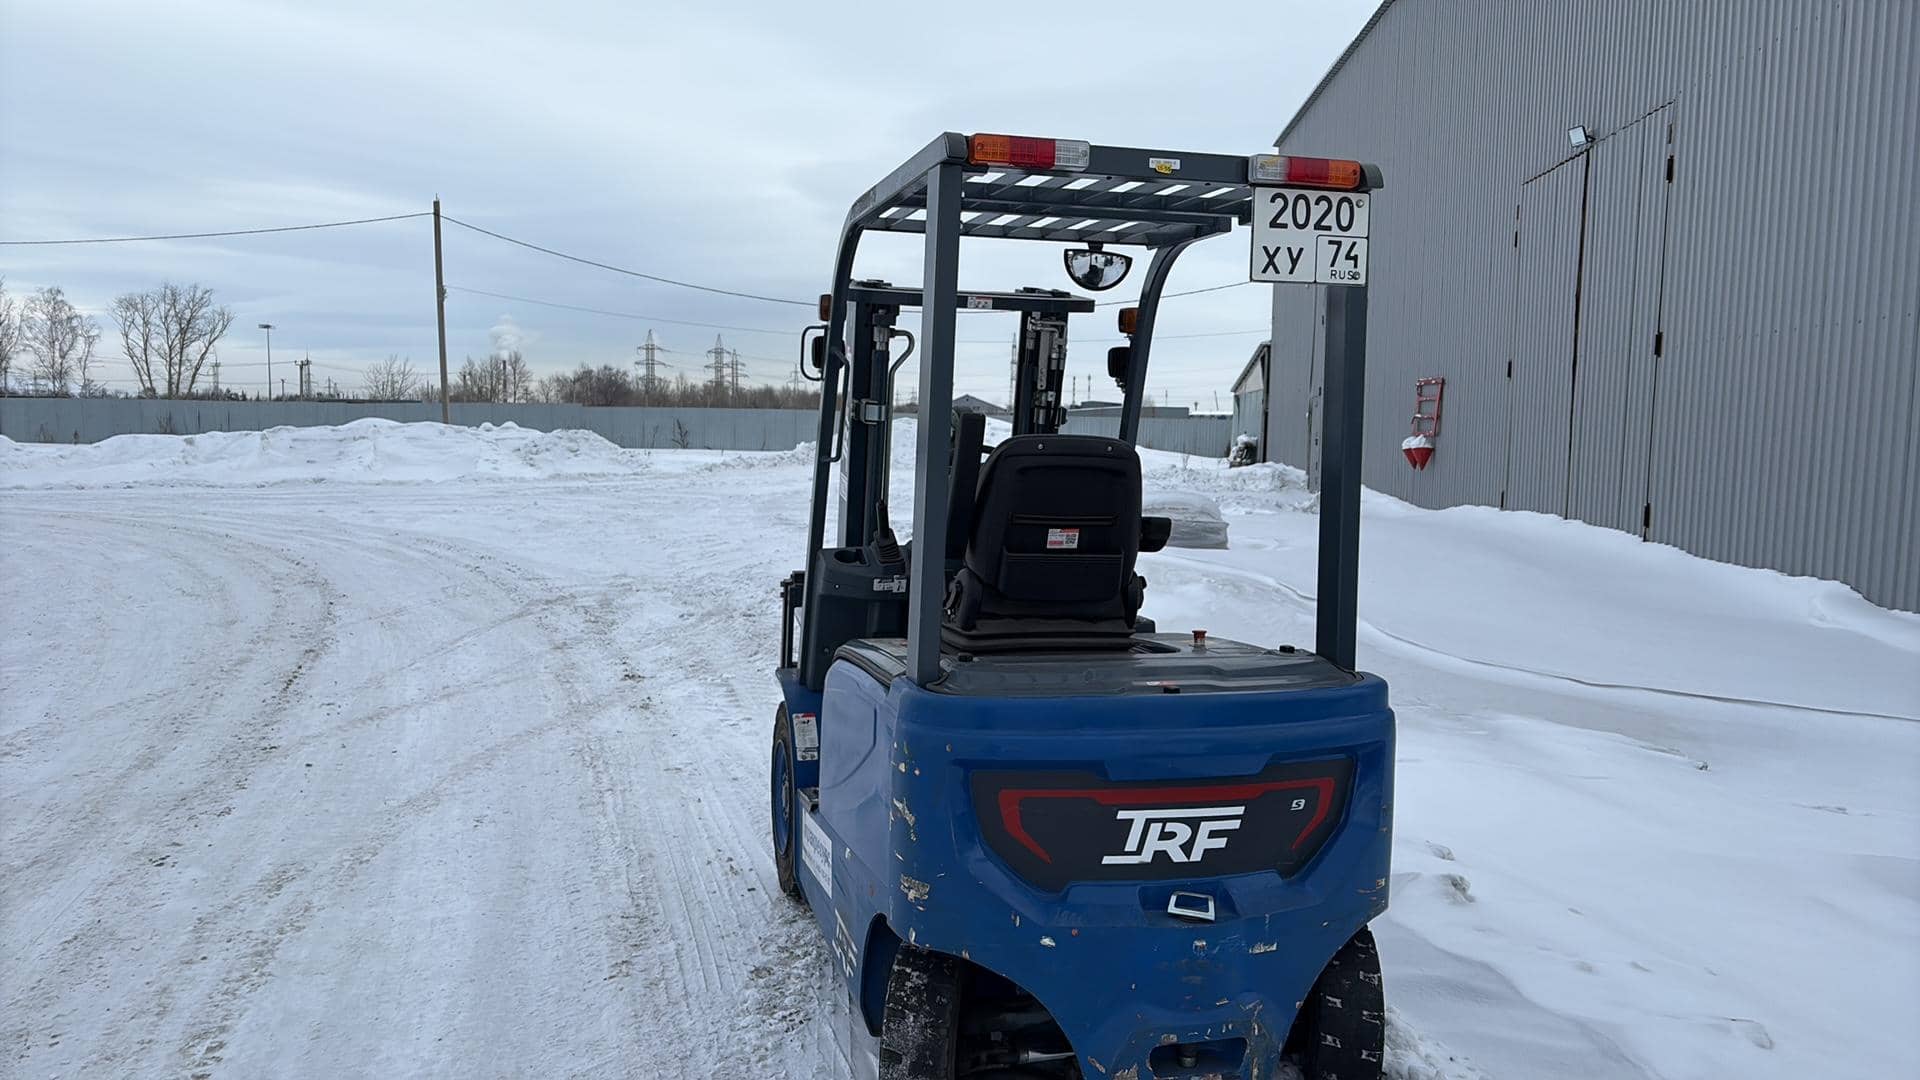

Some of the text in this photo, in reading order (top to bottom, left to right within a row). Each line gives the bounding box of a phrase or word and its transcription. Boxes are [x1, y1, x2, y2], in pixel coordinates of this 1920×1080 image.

[1269, 192, 1355, 232] 2020
[1327, 240, 1359, 269] 74
[1330, 270, 1354, 280] RUS
[1101, 806, 1246, 864] TRF
